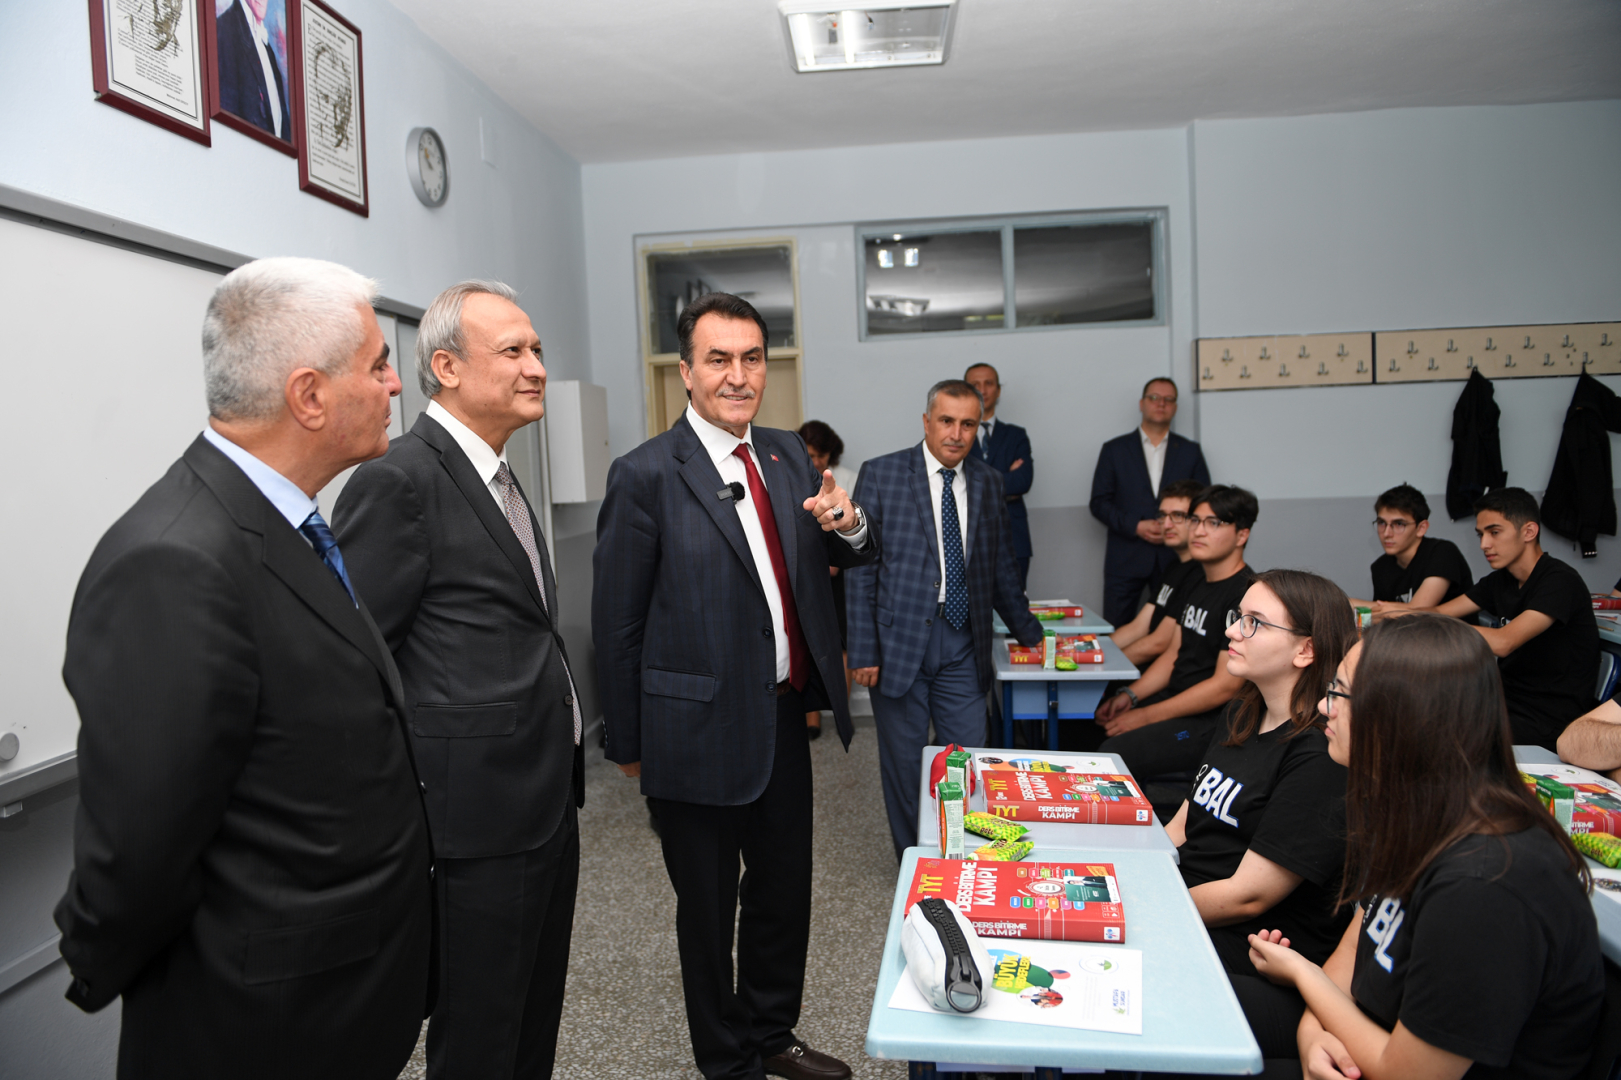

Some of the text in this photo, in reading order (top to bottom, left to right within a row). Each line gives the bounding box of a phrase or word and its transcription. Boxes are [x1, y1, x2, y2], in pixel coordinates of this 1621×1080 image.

[1184, 604, 1208, 636] BAL
[1013, 655, 1029, 663] TYT
[988, 778, 1008, 791] TYT
[1028, 774, 1053, 799] KAMPI
[1193, 766, 1244, 829] BAL
[993, 804, 1020, 818] TYT
[1042, 811, 1075, 820] KAMPI
[917, 873, 944, 894] TYT
[953, 861, 977, 889] BİTİRME
[973, 867, 998, 906] KAMPI
[956, 889, 975, 912] DERS
[972, 920, 1027, 931] DERS BİTİRME
[977, 928, 1021, 937] KAMPI
[994, 953, 1020, 988] BÜYÜK
